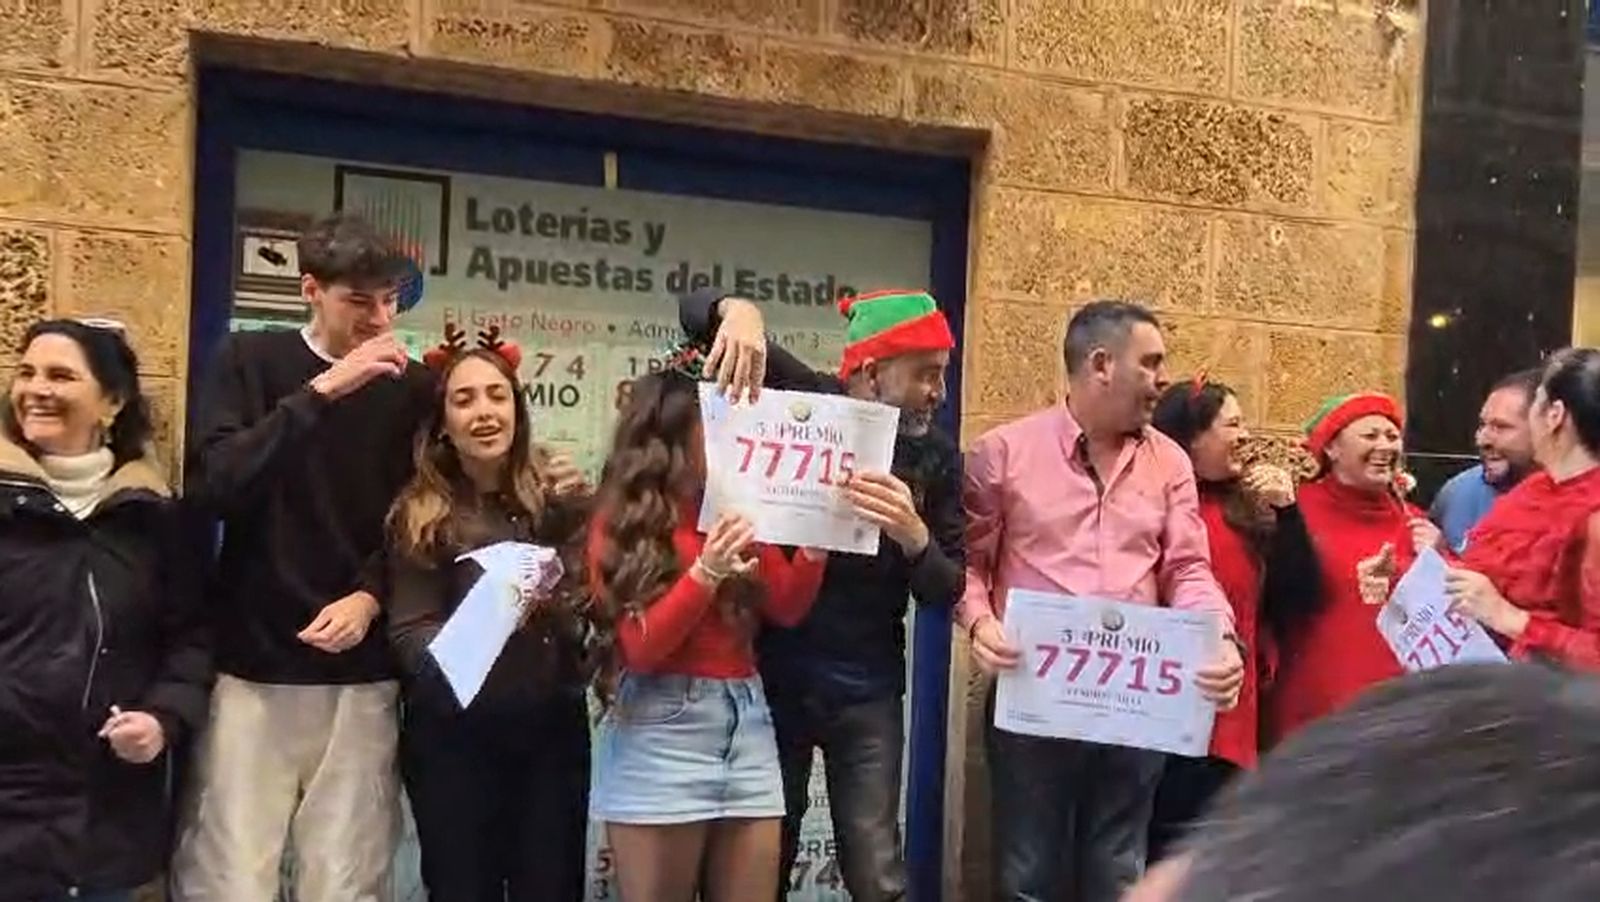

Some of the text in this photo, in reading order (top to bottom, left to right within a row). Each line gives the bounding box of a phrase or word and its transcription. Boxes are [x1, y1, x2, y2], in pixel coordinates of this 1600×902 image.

[644, 221, 666, 257] y
[466, 246, 653, 293] Apuestas
[666, 262, 722, 294] del
[531, 311, 595, 336] Negro
[735, 436, 857, 489] 77715
[1035, 644, 1183, 696] 77715
